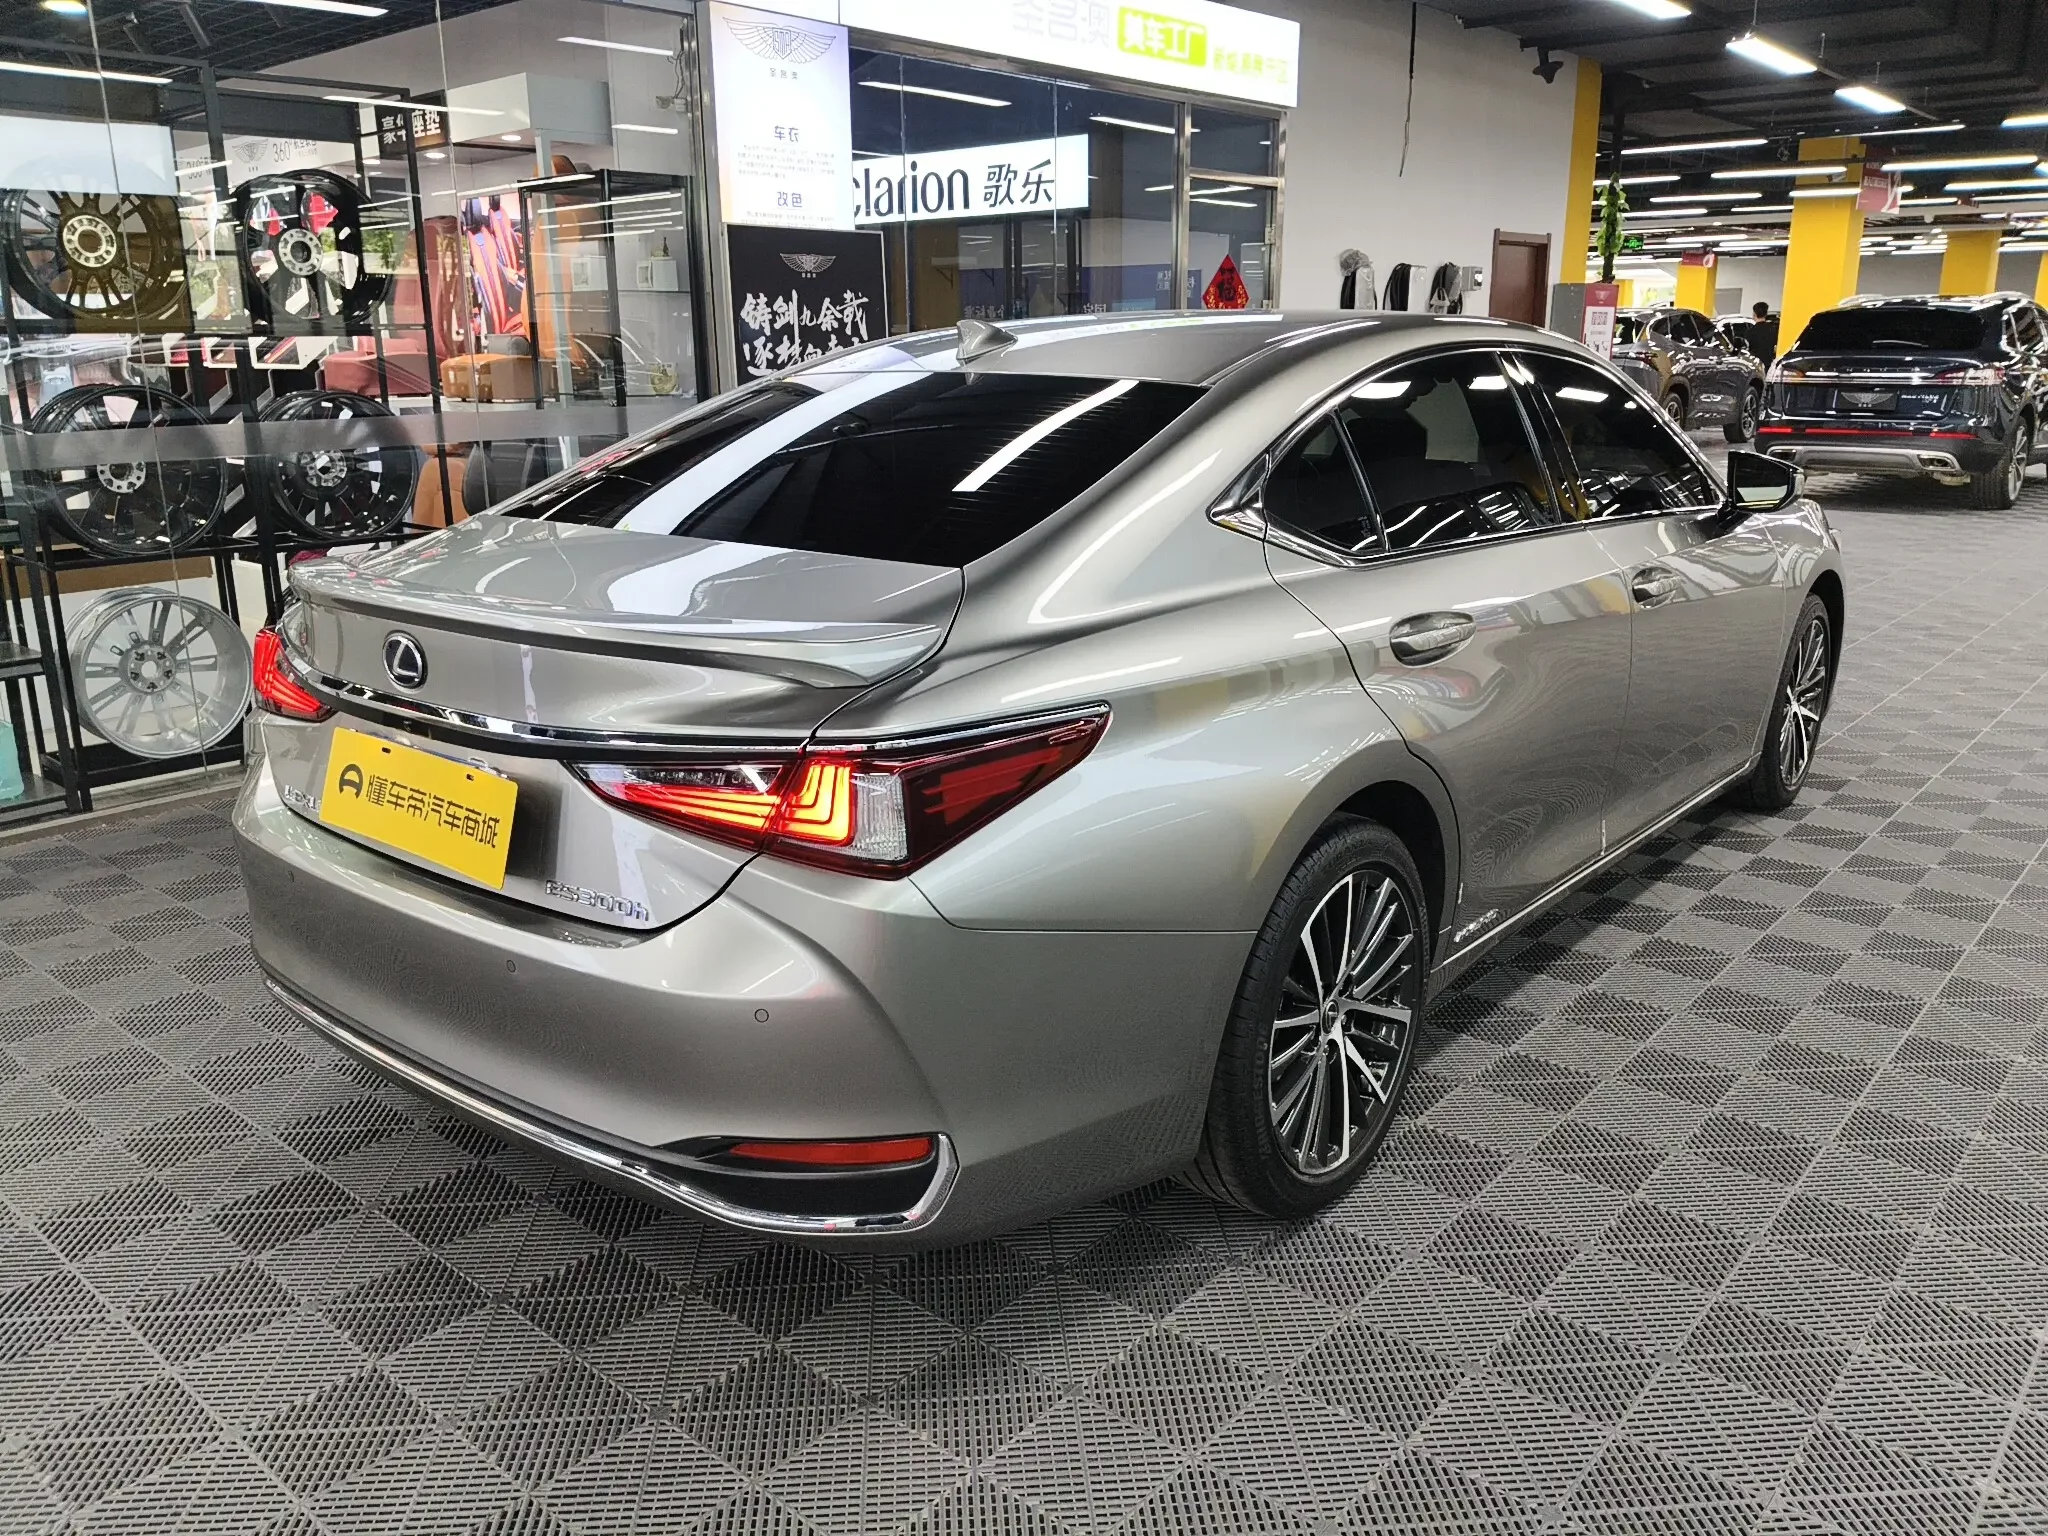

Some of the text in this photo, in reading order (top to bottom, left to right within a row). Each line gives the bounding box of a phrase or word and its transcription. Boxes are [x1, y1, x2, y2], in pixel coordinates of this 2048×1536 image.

[774, 125, 799, 142] 车衣
[777, 191, 803, 208] 改色
[983, 158, 1055, 208] 歌乐
[364, 774, 501, 849] 懂车帝汽车商城
[545, 880, 649, 921] ES300h
